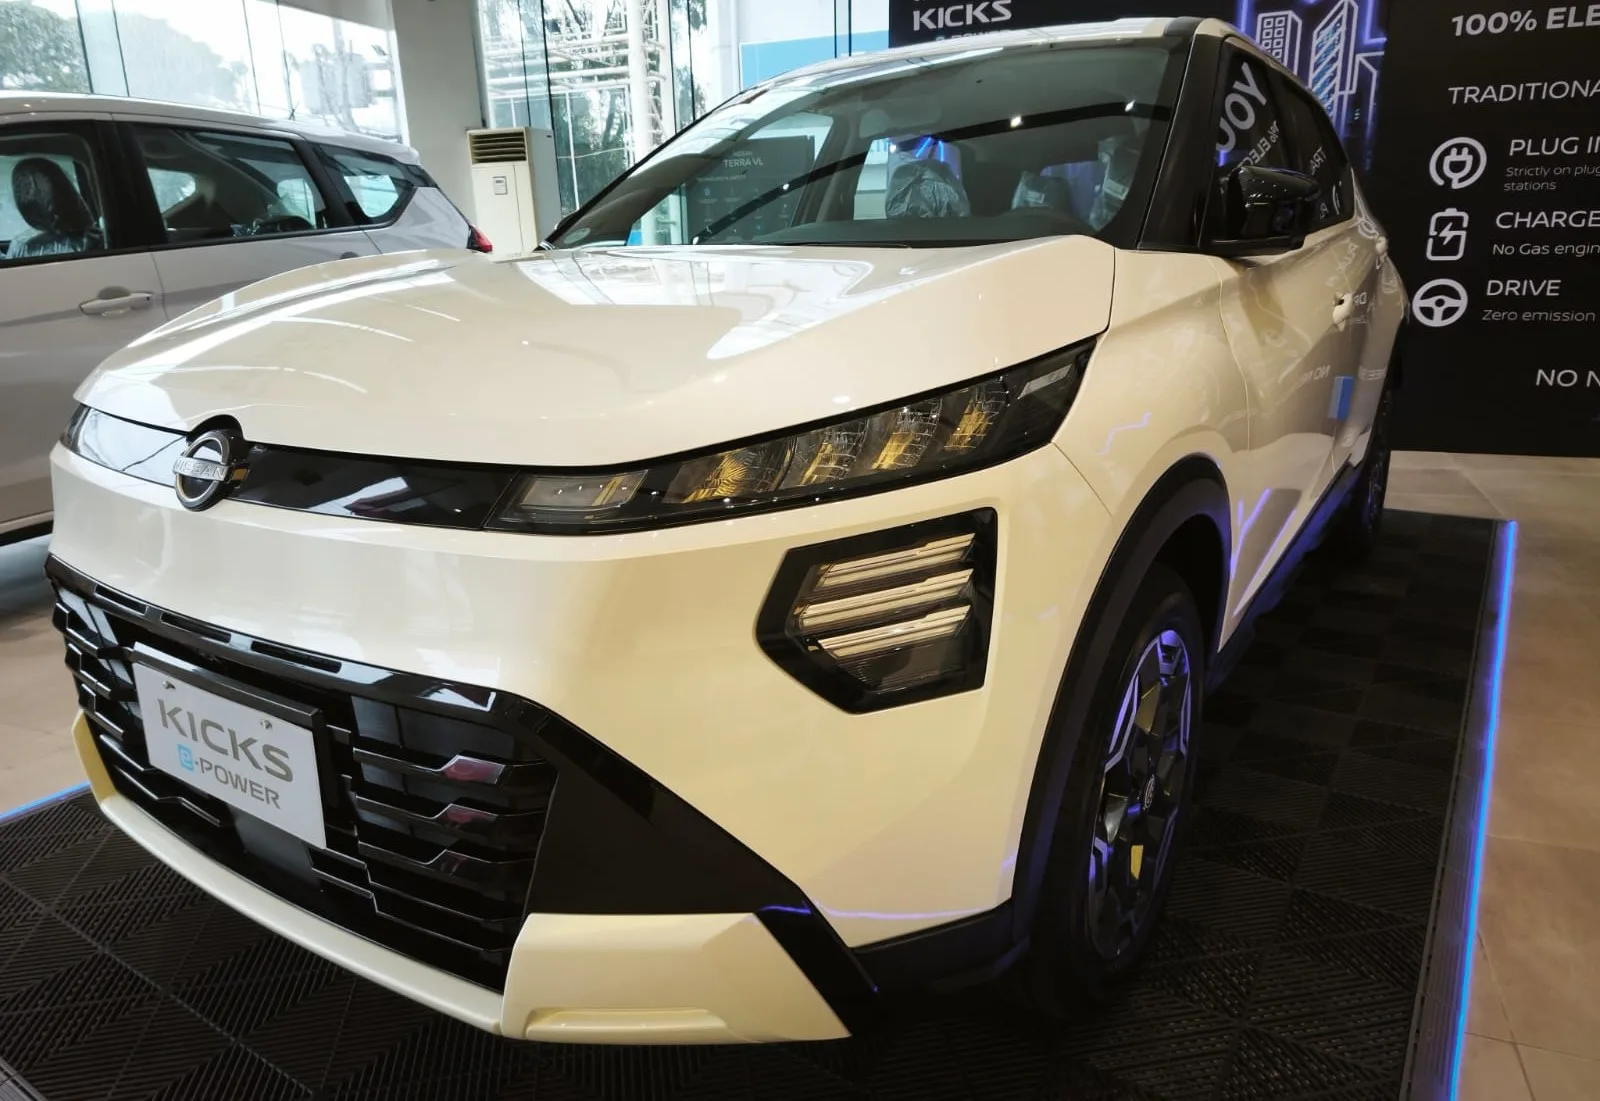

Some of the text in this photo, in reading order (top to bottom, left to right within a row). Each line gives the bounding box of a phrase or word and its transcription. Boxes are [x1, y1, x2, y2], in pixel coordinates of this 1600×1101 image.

[913, 0, 1012, 31] KICKS
[1451, 10, 1537, 36] 100%
[1509, 137, 1579, 156] PLUG
[1506, 166, 1550, 177] Strictly
[1553, 167, 1571, 175] on
[1504, 181, 1557, 191] stations
[1496, 210, 1600, 229] CHARGE
[1492, 244, 1515, 255] No
[1519, 243, 1550, 255] Gas
[1486, 279, 1562, 296] DRIVE
[1482, 309, 1596, 322] Zero emission
[1536, 369, 1578, 387] NO
[157, 698, 294, 783] KICKS
